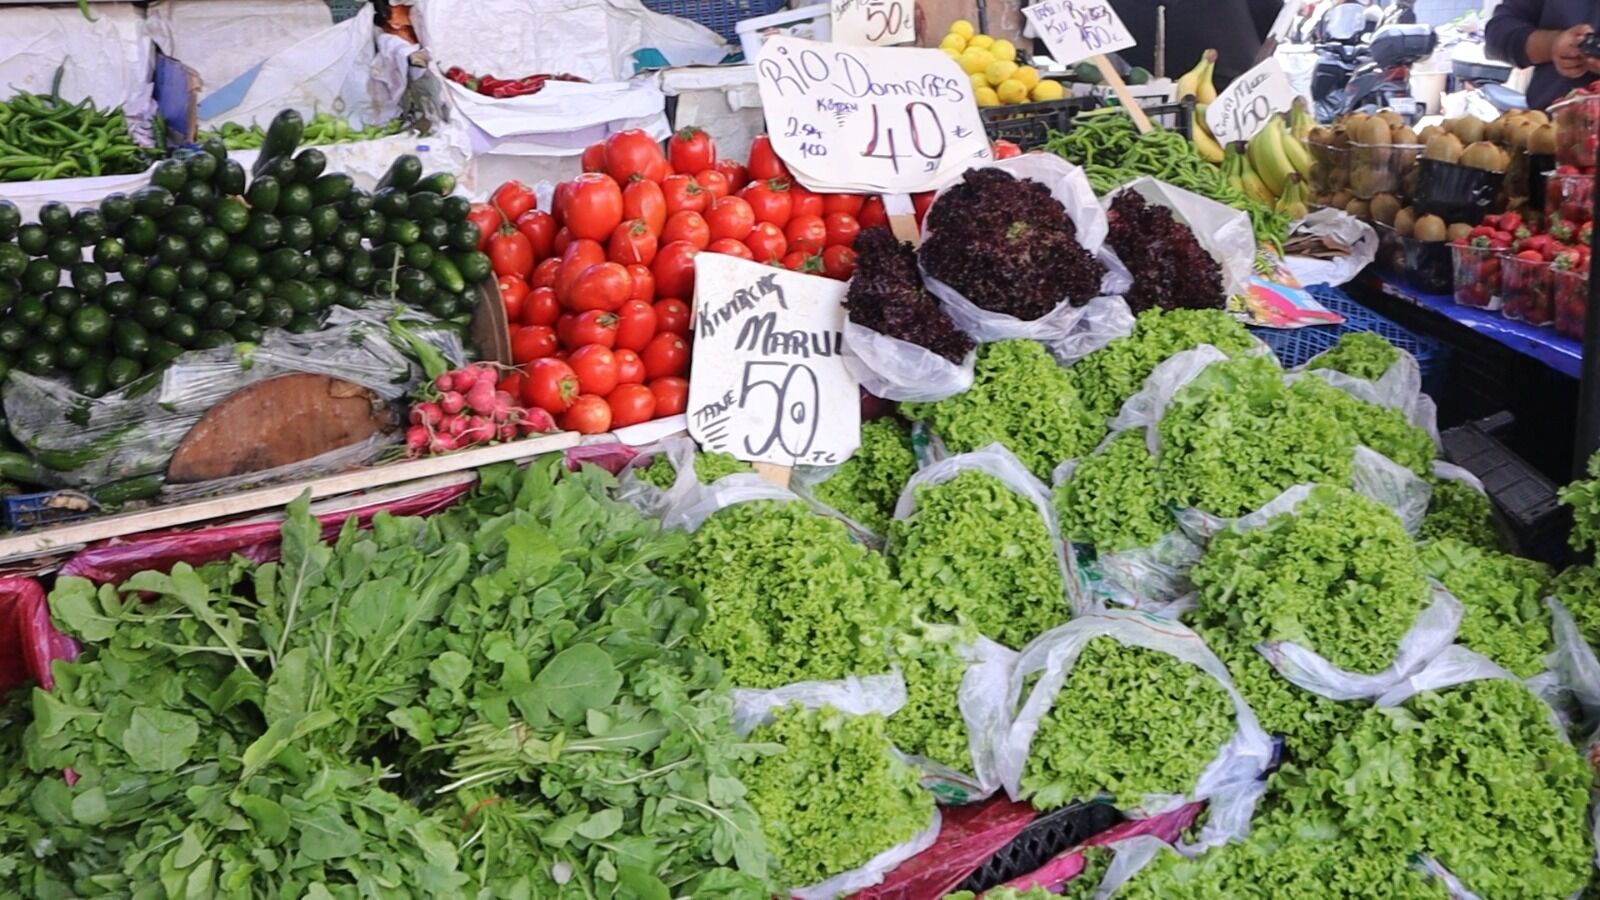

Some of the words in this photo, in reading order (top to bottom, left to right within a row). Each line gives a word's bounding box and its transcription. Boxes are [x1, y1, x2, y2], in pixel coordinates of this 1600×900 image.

[866, 1, 902, 42] 50
[859, 101, 946, 175] 40
[738, 360, 820, 458] 50
